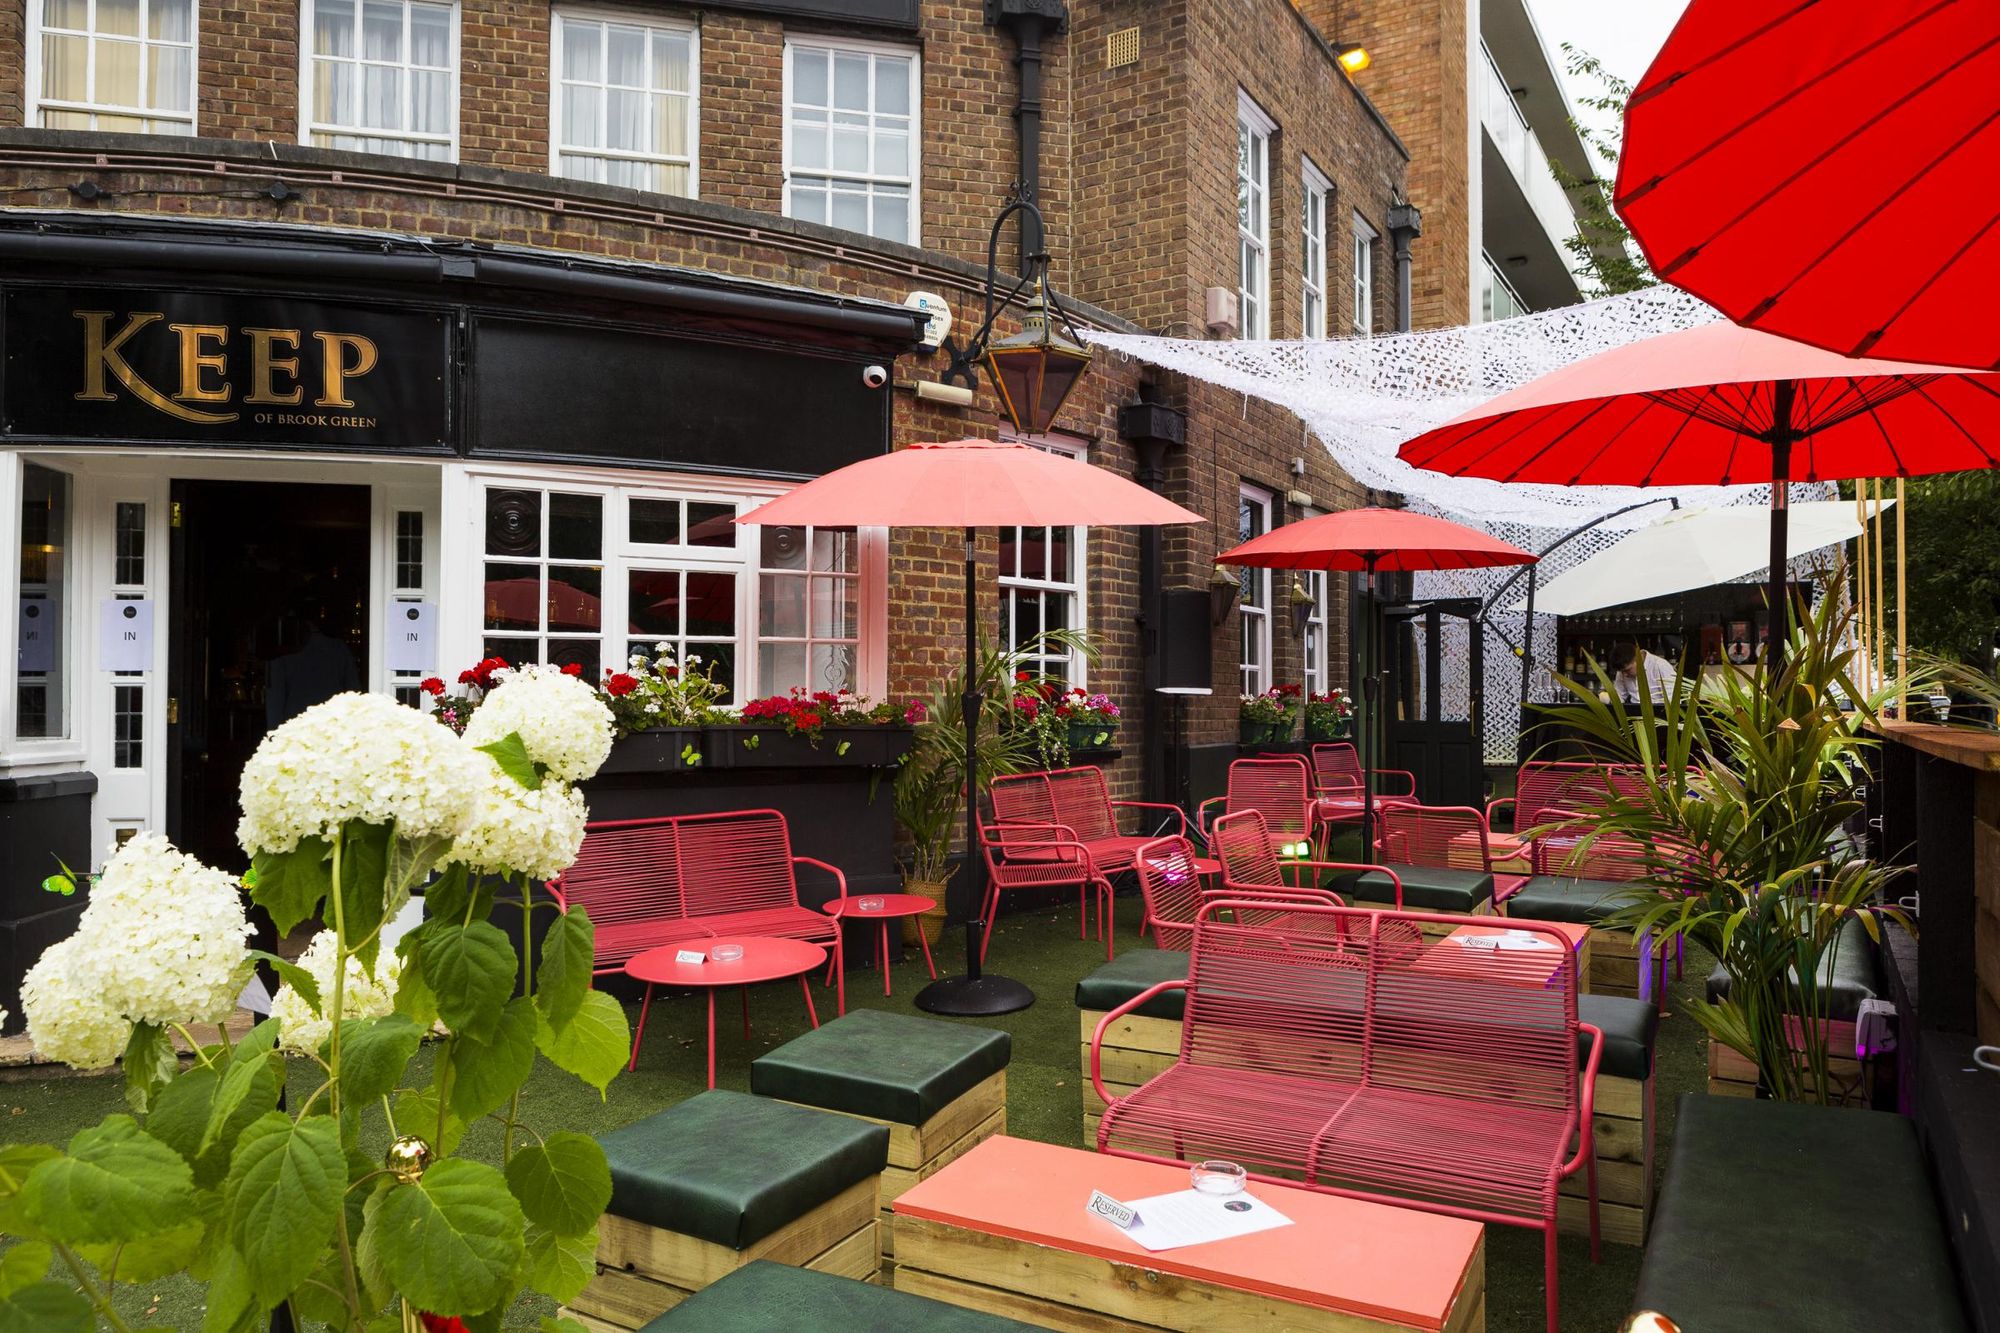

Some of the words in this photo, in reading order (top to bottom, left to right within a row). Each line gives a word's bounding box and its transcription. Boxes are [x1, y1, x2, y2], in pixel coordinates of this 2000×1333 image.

[73, 310, 379, 425] KEEP
[254, 413, 273, 424] OF
[278, 414, 328, 426] BROOK
[330, 416, 377, 428] GREEN
[124, 631, 136, 641] IN
[407, 632, 418, 641] IN
[1091, 1195, 1130, 1222] RESERVED
